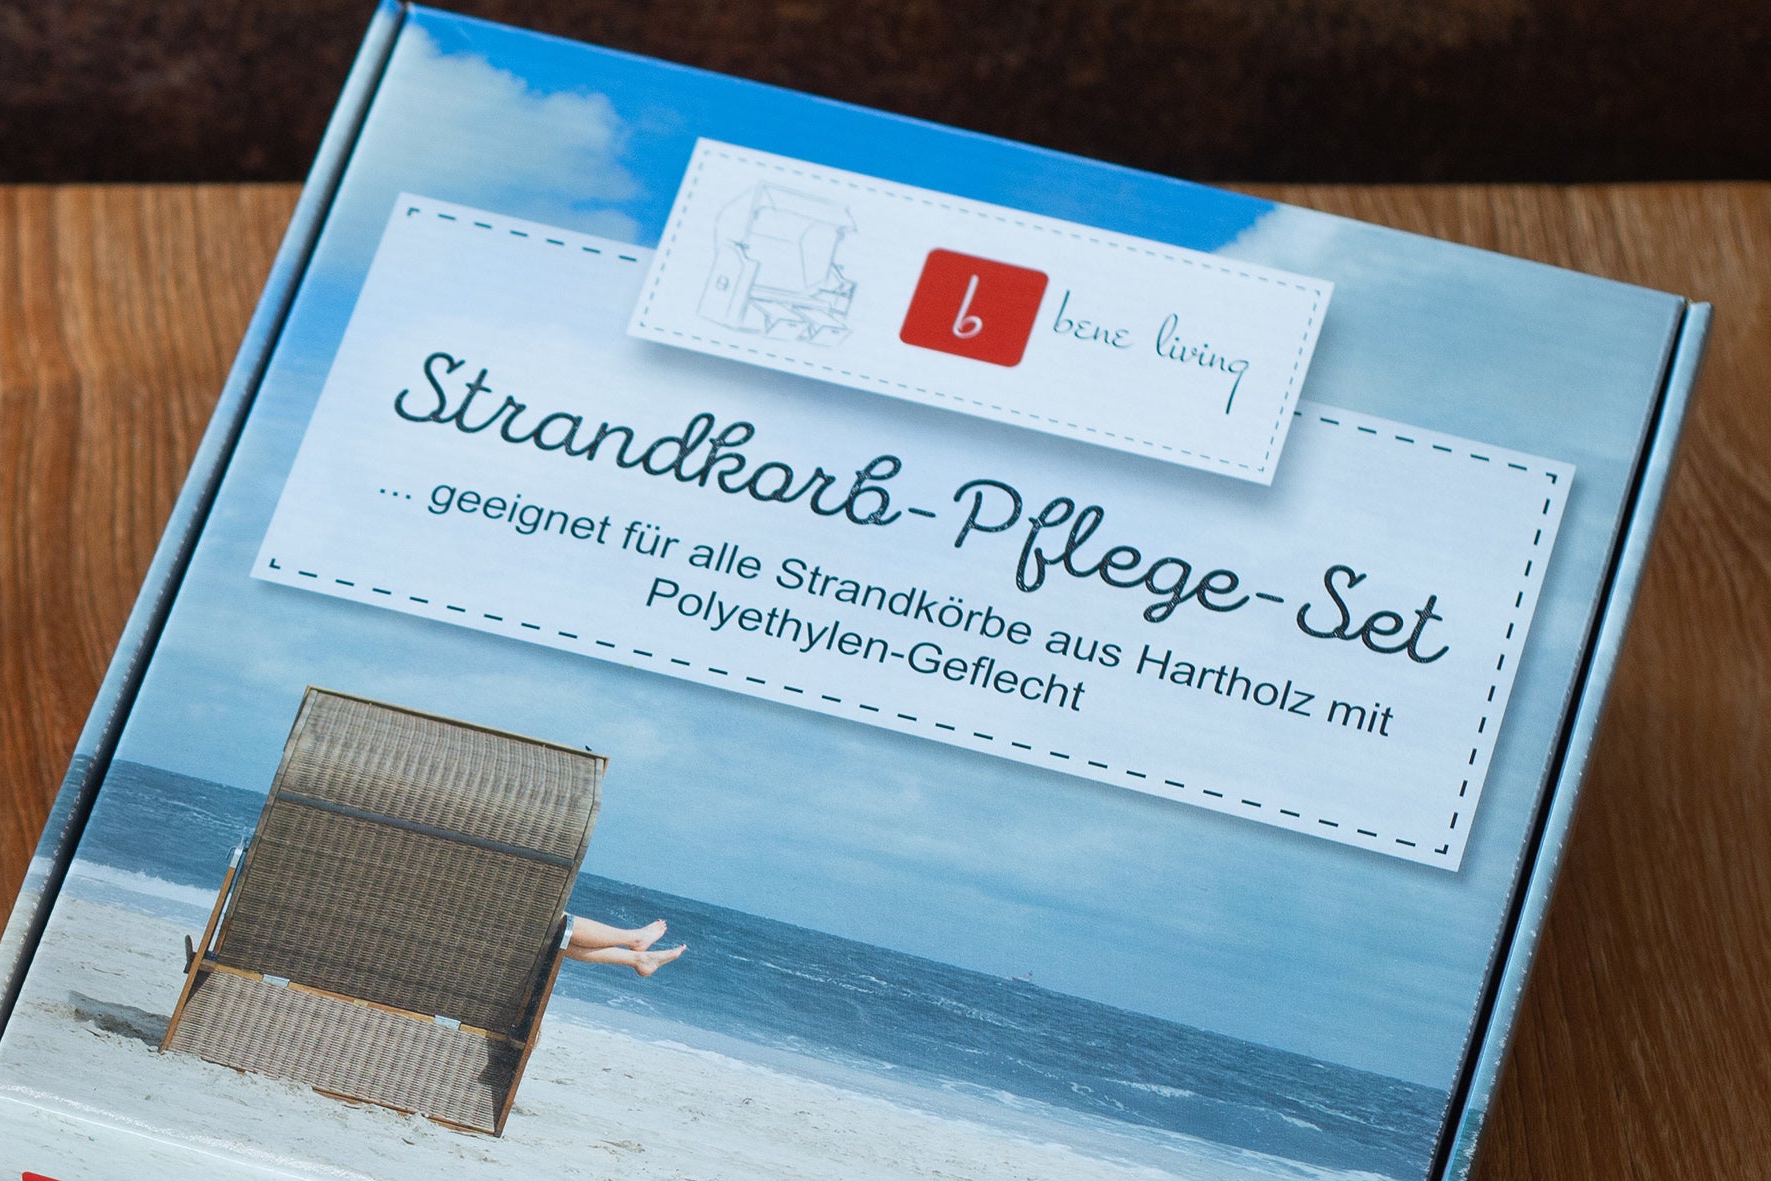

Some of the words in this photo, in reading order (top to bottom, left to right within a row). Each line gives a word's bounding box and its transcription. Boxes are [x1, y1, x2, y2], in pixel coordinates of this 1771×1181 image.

[394, 352, 1450, 664] Strandkorb-Pflege-Set
[428, 484, 611, 545] geeignet
[622, 520, 680, 559] für
[688, 542, 762, 579] alle
[776, 558, 1032, 645] Strandkörbe
[1045, 631, 1122, 668] aus
[1136, 644, 1315, 717] Hartholz
[1327, 700, 1394, 737] mit
[645, 577, 1085, 712] Polyethylen-Geflecht
